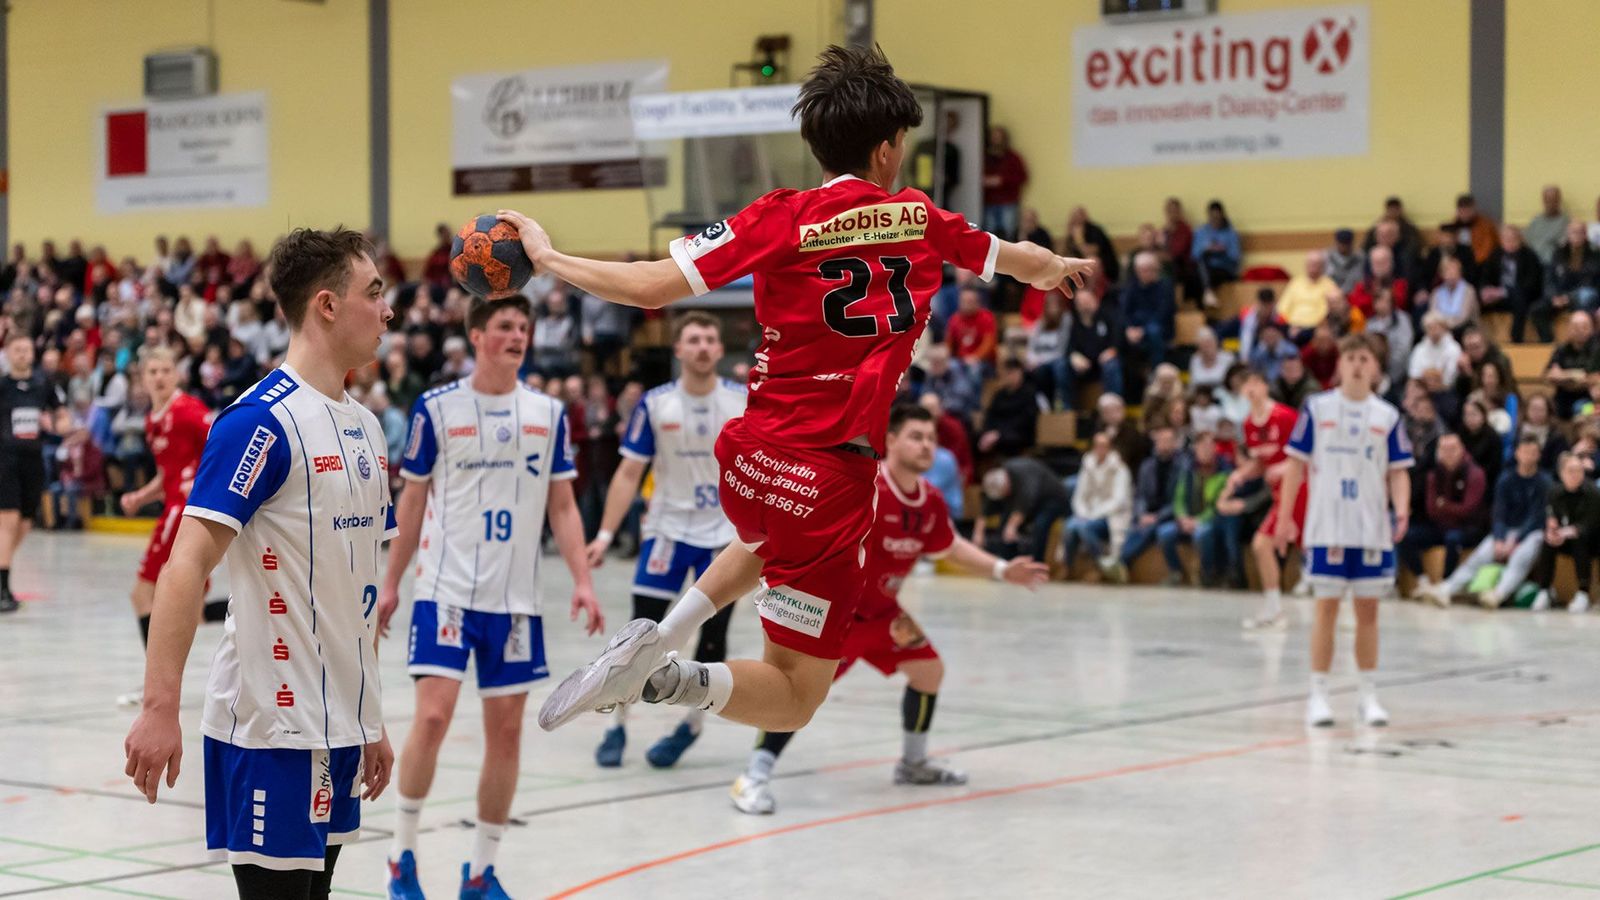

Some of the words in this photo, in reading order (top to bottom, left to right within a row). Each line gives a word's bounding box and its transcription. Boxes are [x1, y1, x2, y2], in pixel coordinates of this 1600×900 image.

[1085, 28, 1290, 92] exciting
[802, 209, 892, 243] Aktobis
[898, 206, 927, 226] AG
[864, 231, 900, 241] E-Heizer
[904, 228, 924, 237] Klima
[818, 256, 917, 338] 21
[232, 429, 269, 492] AQUASAN
[313, 455, 343, 473] SABO
[456, 458, 514, 470] Kienbaum
[724, 470, 755, 499] 06106
[735, 454, 771, 484] Sabine
[772, 475, 819, 499] Brauch
[1341, 479, 1358, 499] 10
[695, 485, 718, 508] 53
[482, 509, 512, 542] 19
[762, 598, 820, 628] Seligenstadt
